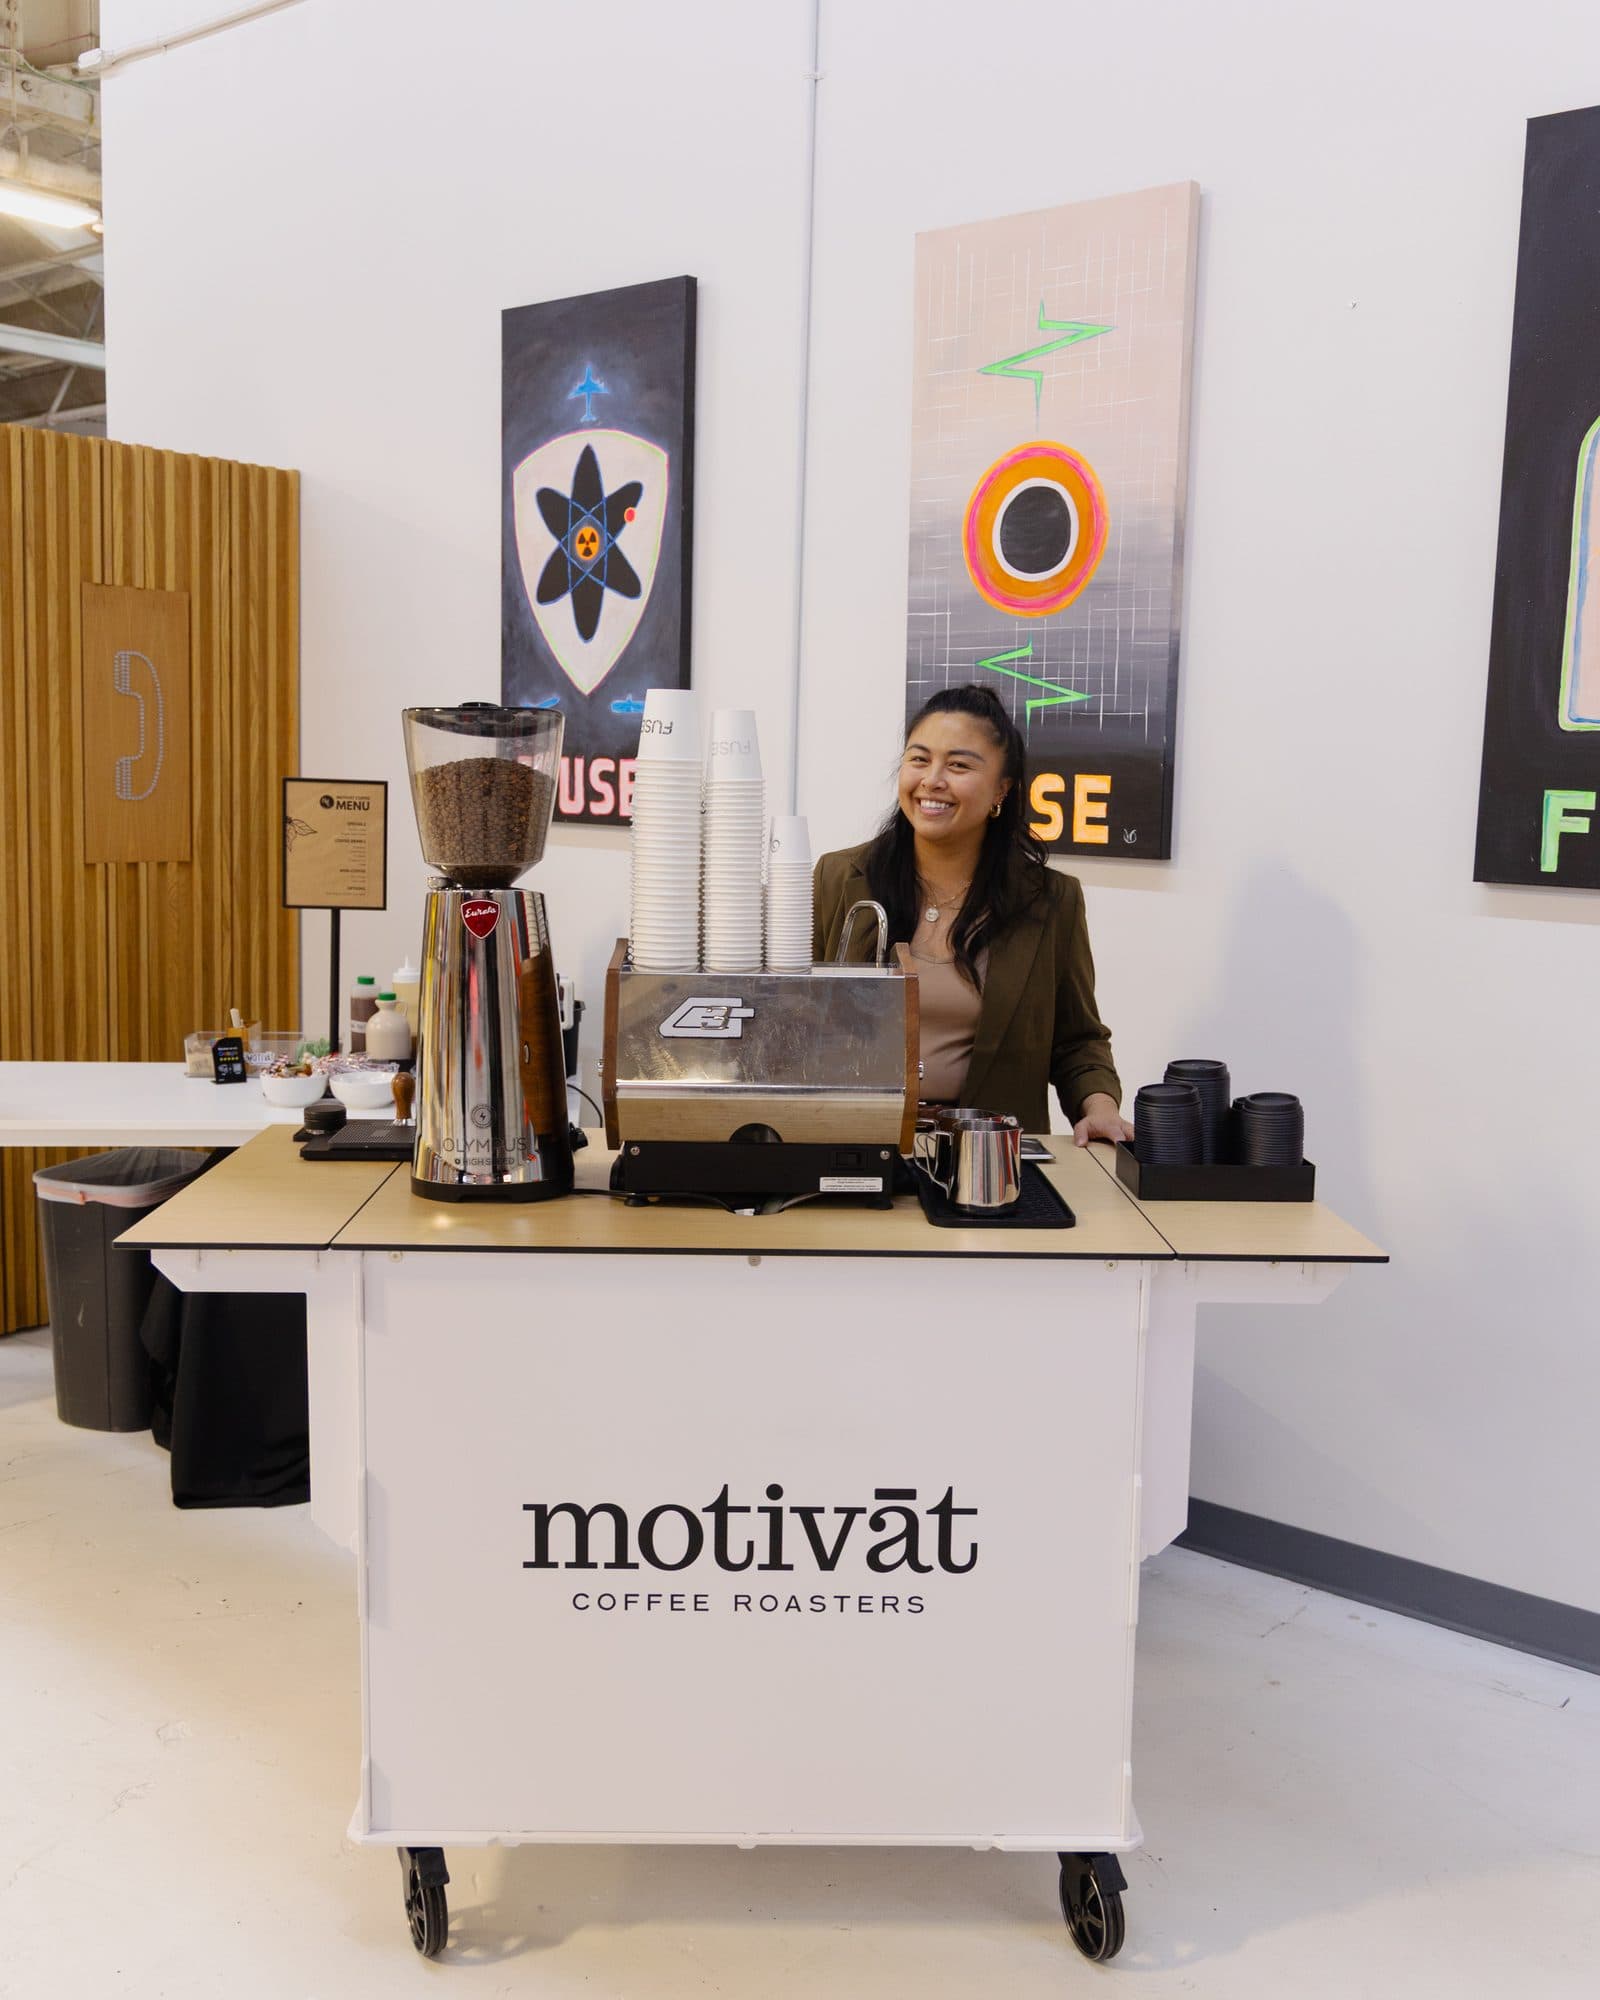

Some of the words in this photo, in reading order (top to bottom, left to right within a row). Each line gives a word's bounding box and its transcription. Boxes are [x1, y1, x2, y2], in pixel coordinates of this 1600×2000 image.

[336, 800, 370, 811] MENU
[517, 755, 640, 816] USE
[1029, 773, 1111, 844] SE
[523, 1484, 977, 1574] motivāt
[573, 1593, 709, 1611] COFFEE
[735, 1595, 924, 1613] ROASTERS
